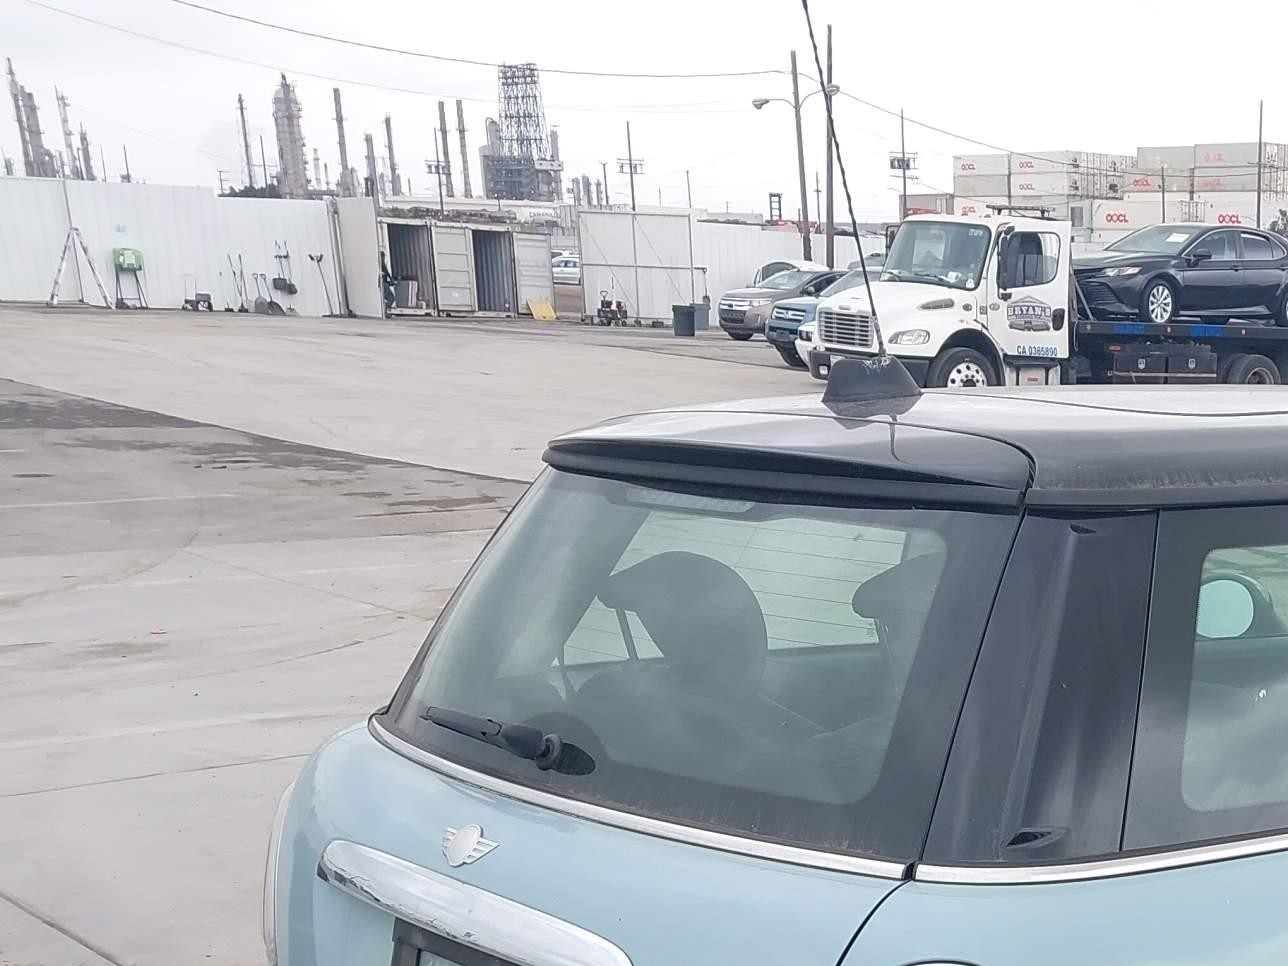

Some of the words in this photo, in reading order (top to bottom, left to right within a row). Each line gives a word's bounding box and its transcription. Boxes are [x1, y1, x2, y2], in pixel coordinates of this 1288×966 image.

[1106, 213, 1129, 223] OOCL
[1217, 214, 1242, 224] OOCL
[1016, 345, 1027, 355] CA
